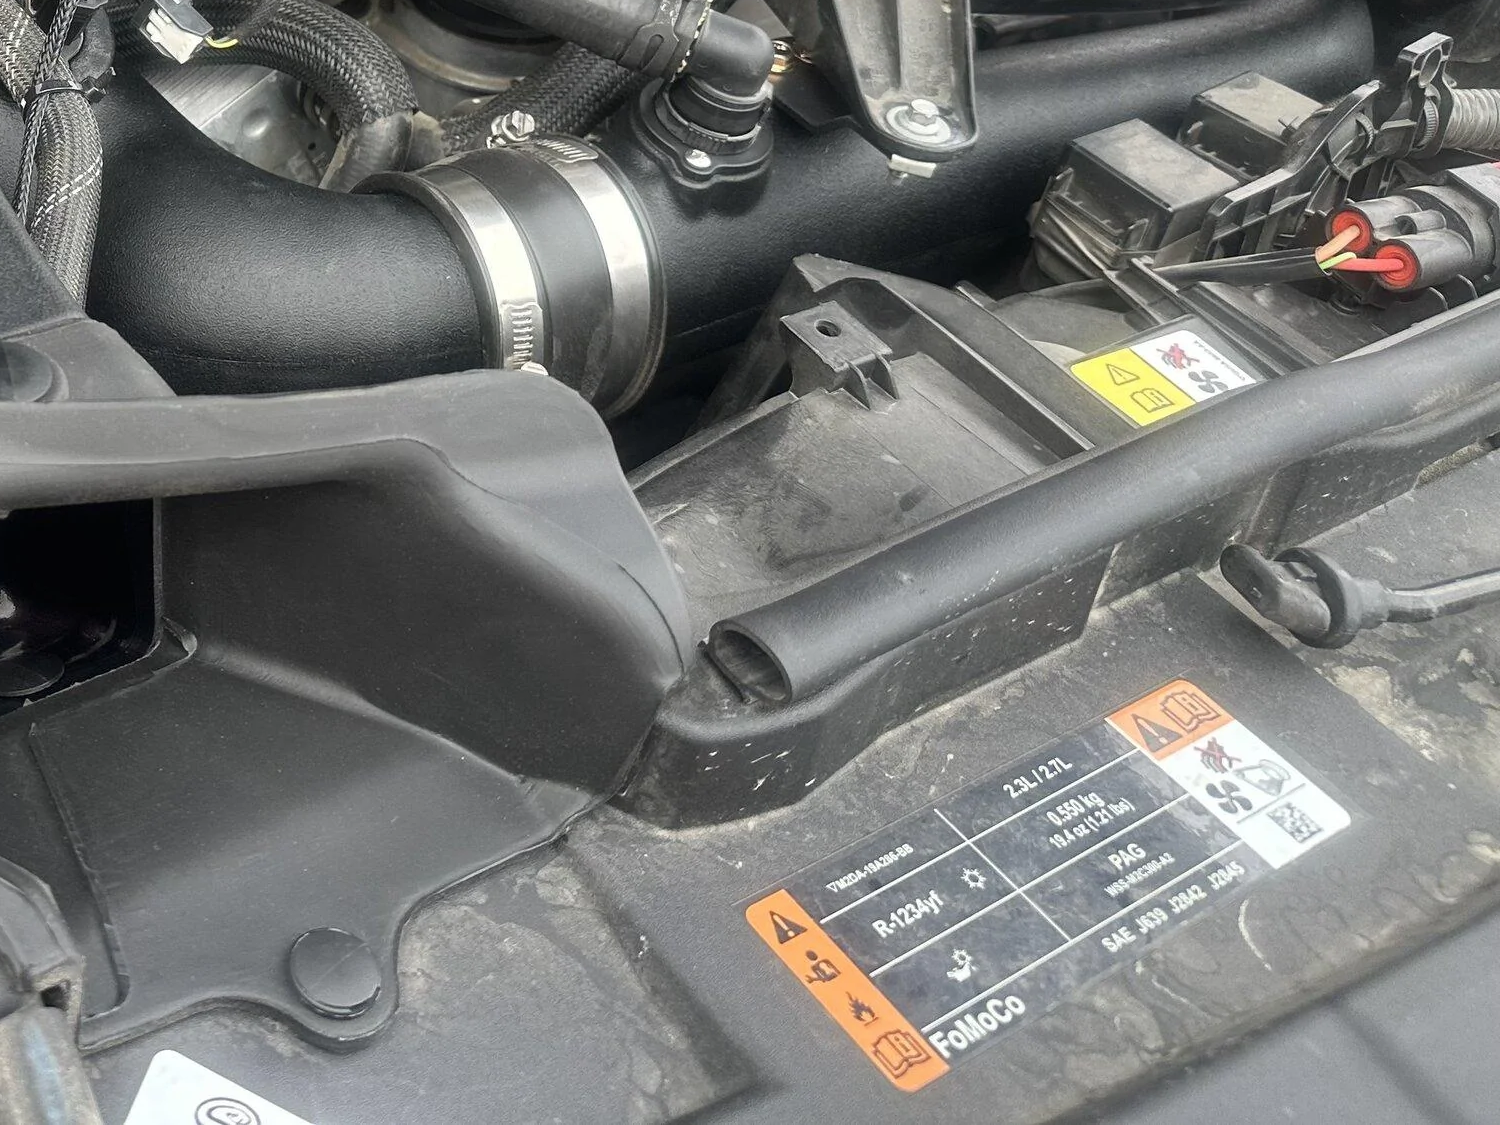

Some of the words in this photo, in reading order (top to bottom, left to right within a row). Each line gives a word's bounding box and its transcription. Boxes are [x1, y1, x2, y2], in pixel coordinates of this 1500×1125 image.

[1002, 775, 1039, 799] 2.3L
[1038, 757, 1073, 780] 2.7L
[1046, 799, 1086, 826] 0.550
[1078, 792, 1105, 808] kg
[1049, 829, 1076, 849] 19.4
[1073, 823, 1091, 838] oz
[1084, 808, 1114, 832] (1.21
[1107, 797, 1136, 816] lbs)
[1107, 843, 1147, 871] PAG
[871, 889, 944, 938] R-1234yf
[1101, 926, 1137, 953] SAE
[1134, 907, 1169, 935] J639
[1167, 884, 1208, 914] J2842
[928, 995, 1026, 1059] FoMoCo
